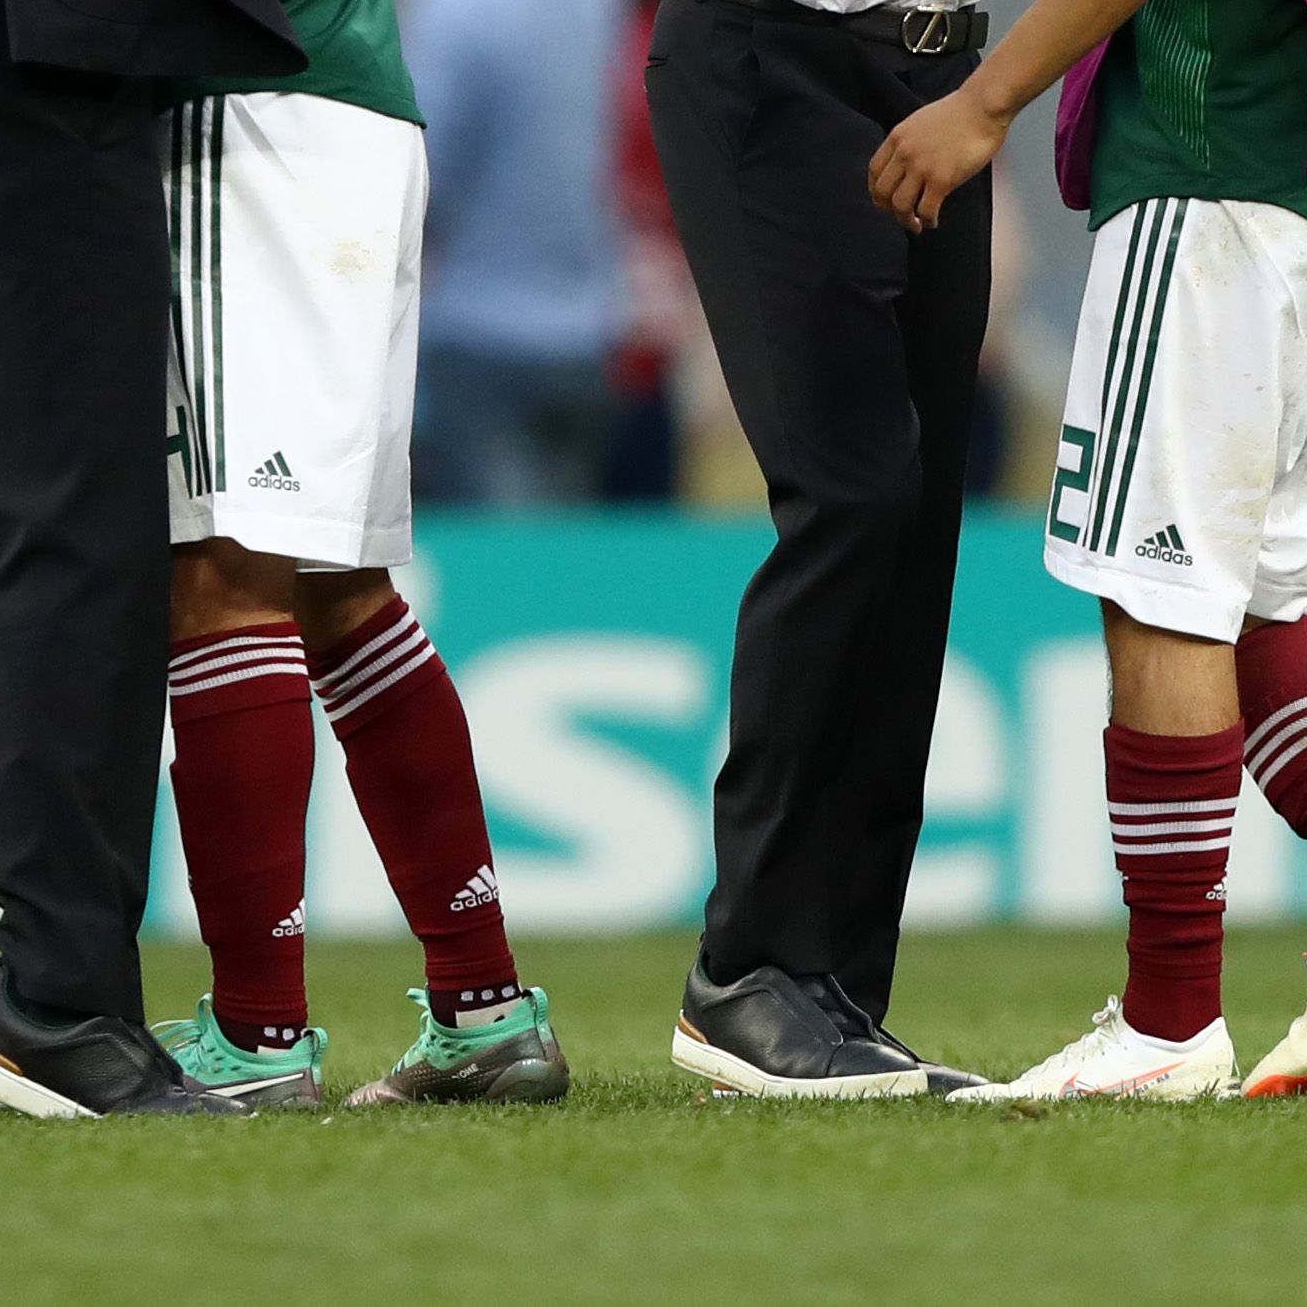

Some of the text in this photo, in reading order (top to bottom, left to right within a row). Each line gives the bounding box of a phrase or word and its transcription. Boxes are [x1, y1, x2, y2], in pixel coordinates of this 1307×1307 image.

[247, 473, 301, 492] adidas
[1134, 544, 1193, 566] adidas
[450, 887, 500, 911] adid
[272, 922, 305, 937] adid
